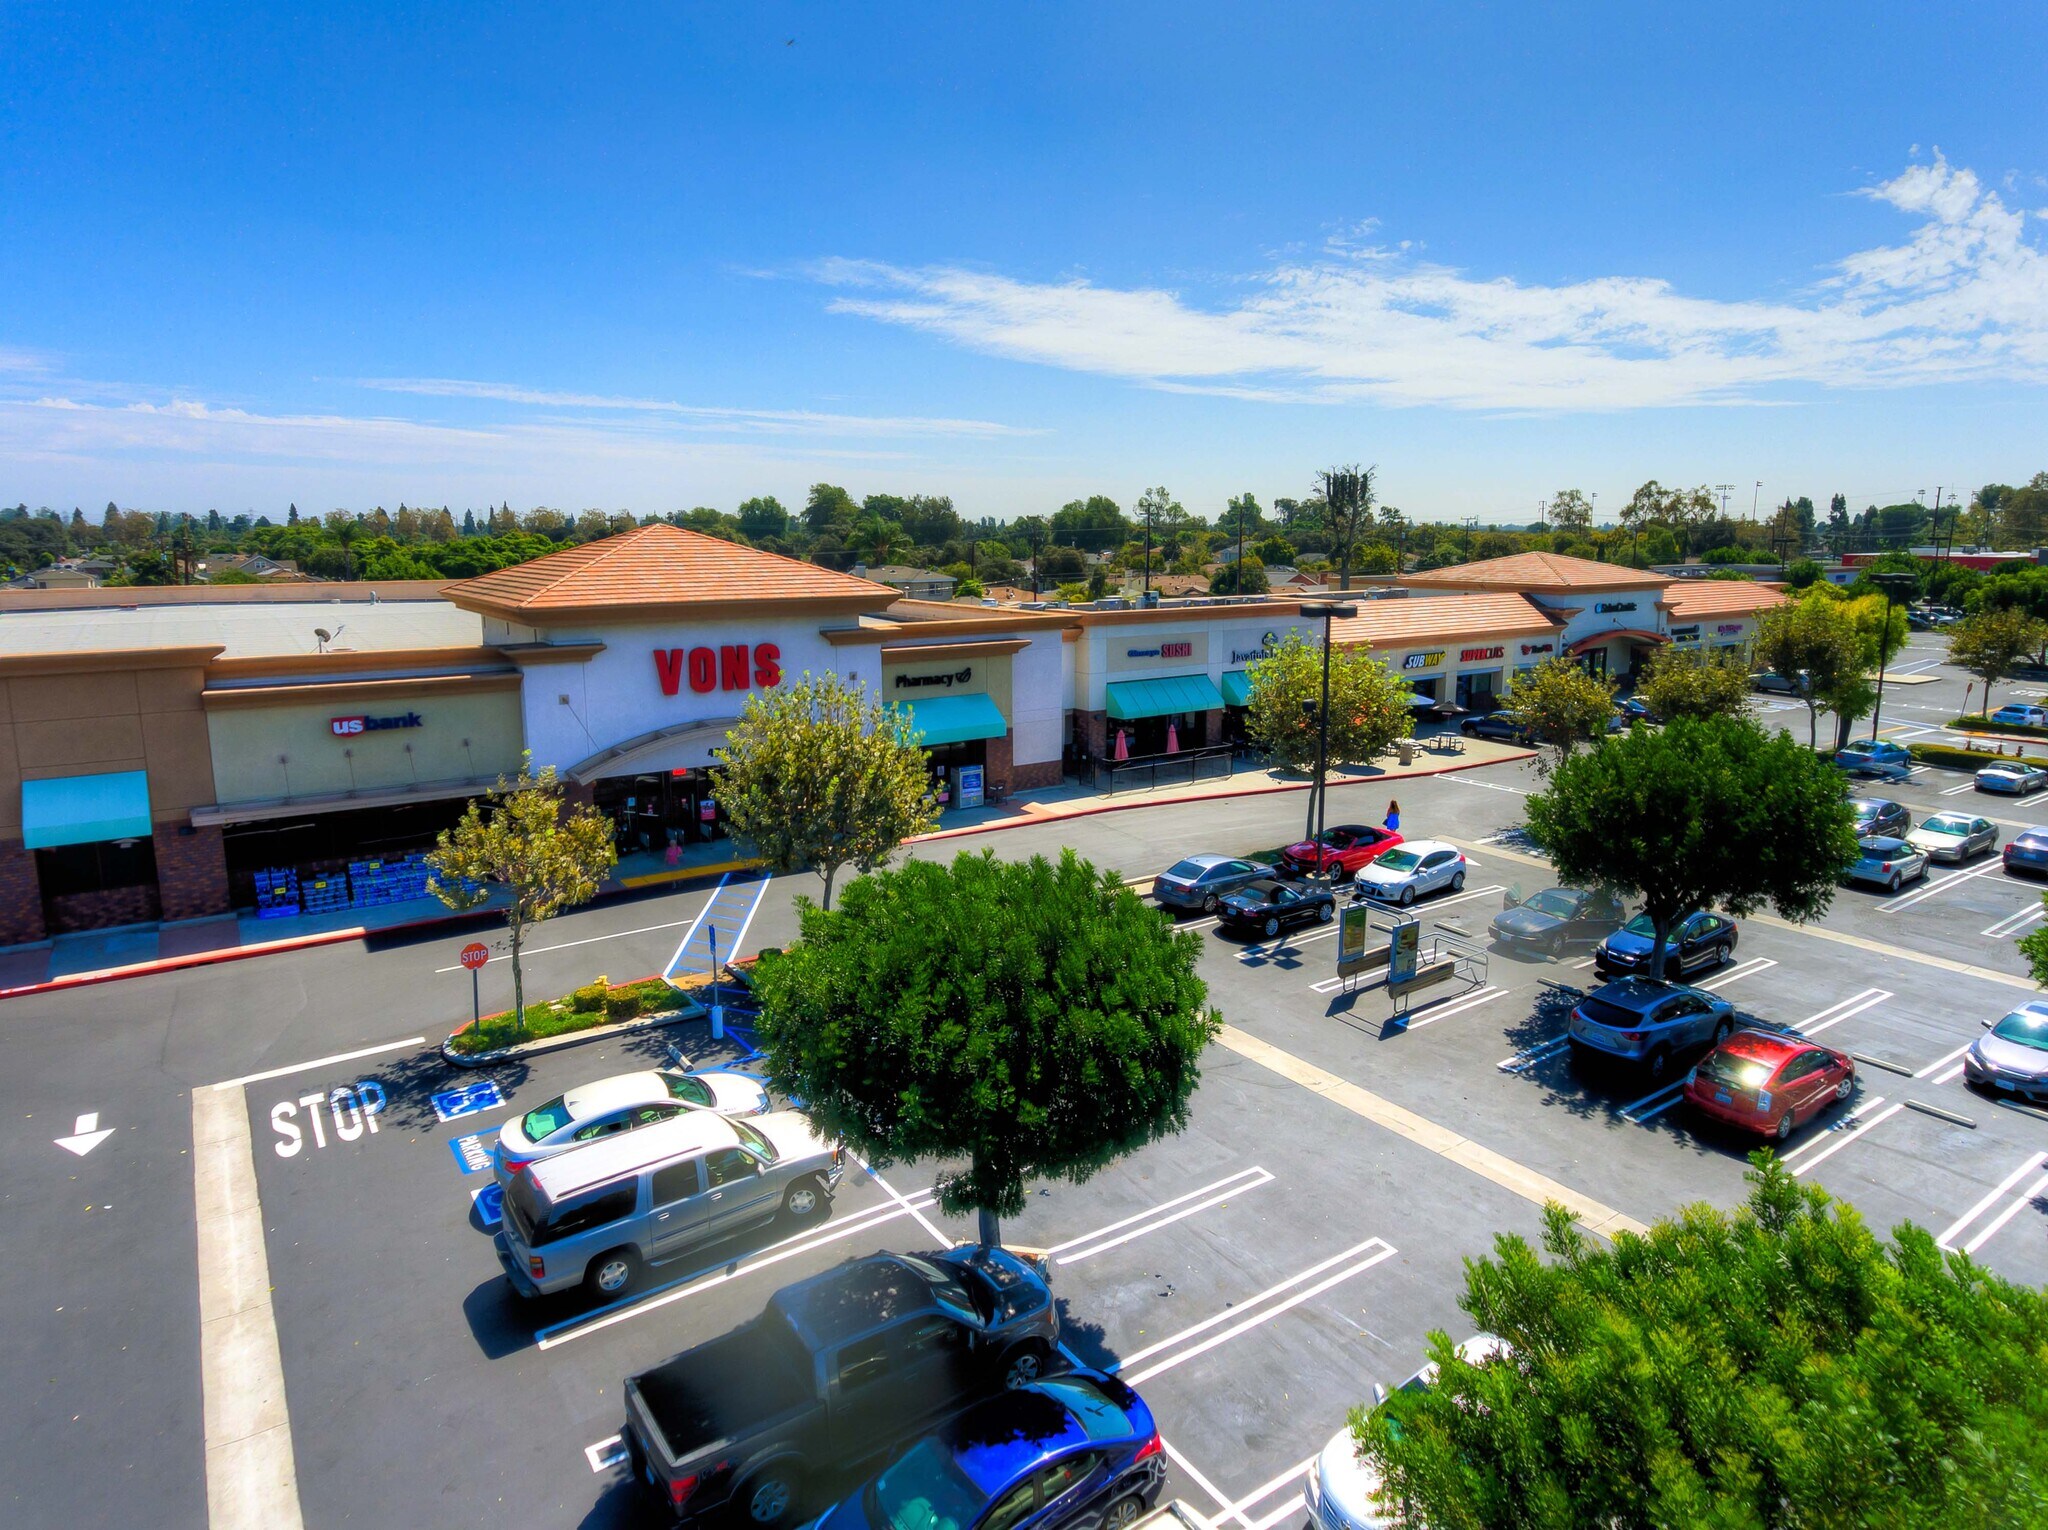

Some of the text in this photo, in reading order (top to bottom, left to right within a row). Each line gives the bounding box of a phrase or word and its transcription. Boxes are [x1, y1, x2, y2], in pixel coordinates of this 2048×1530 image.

[1161, 643, 1192, 658] SUSHI
[1460, 647, 1504, 662] SUPERCUTS
[1404, 651, 1446, 669] SUBWAY
[653, 642, 782, 696] VONS
[896, 674, 953, 688] Pharmacy
[462, 949, 487, 963] STOP
[271, 1081, 386, 1158] STOP
[457, 1134, 491, 1171] PARKING
